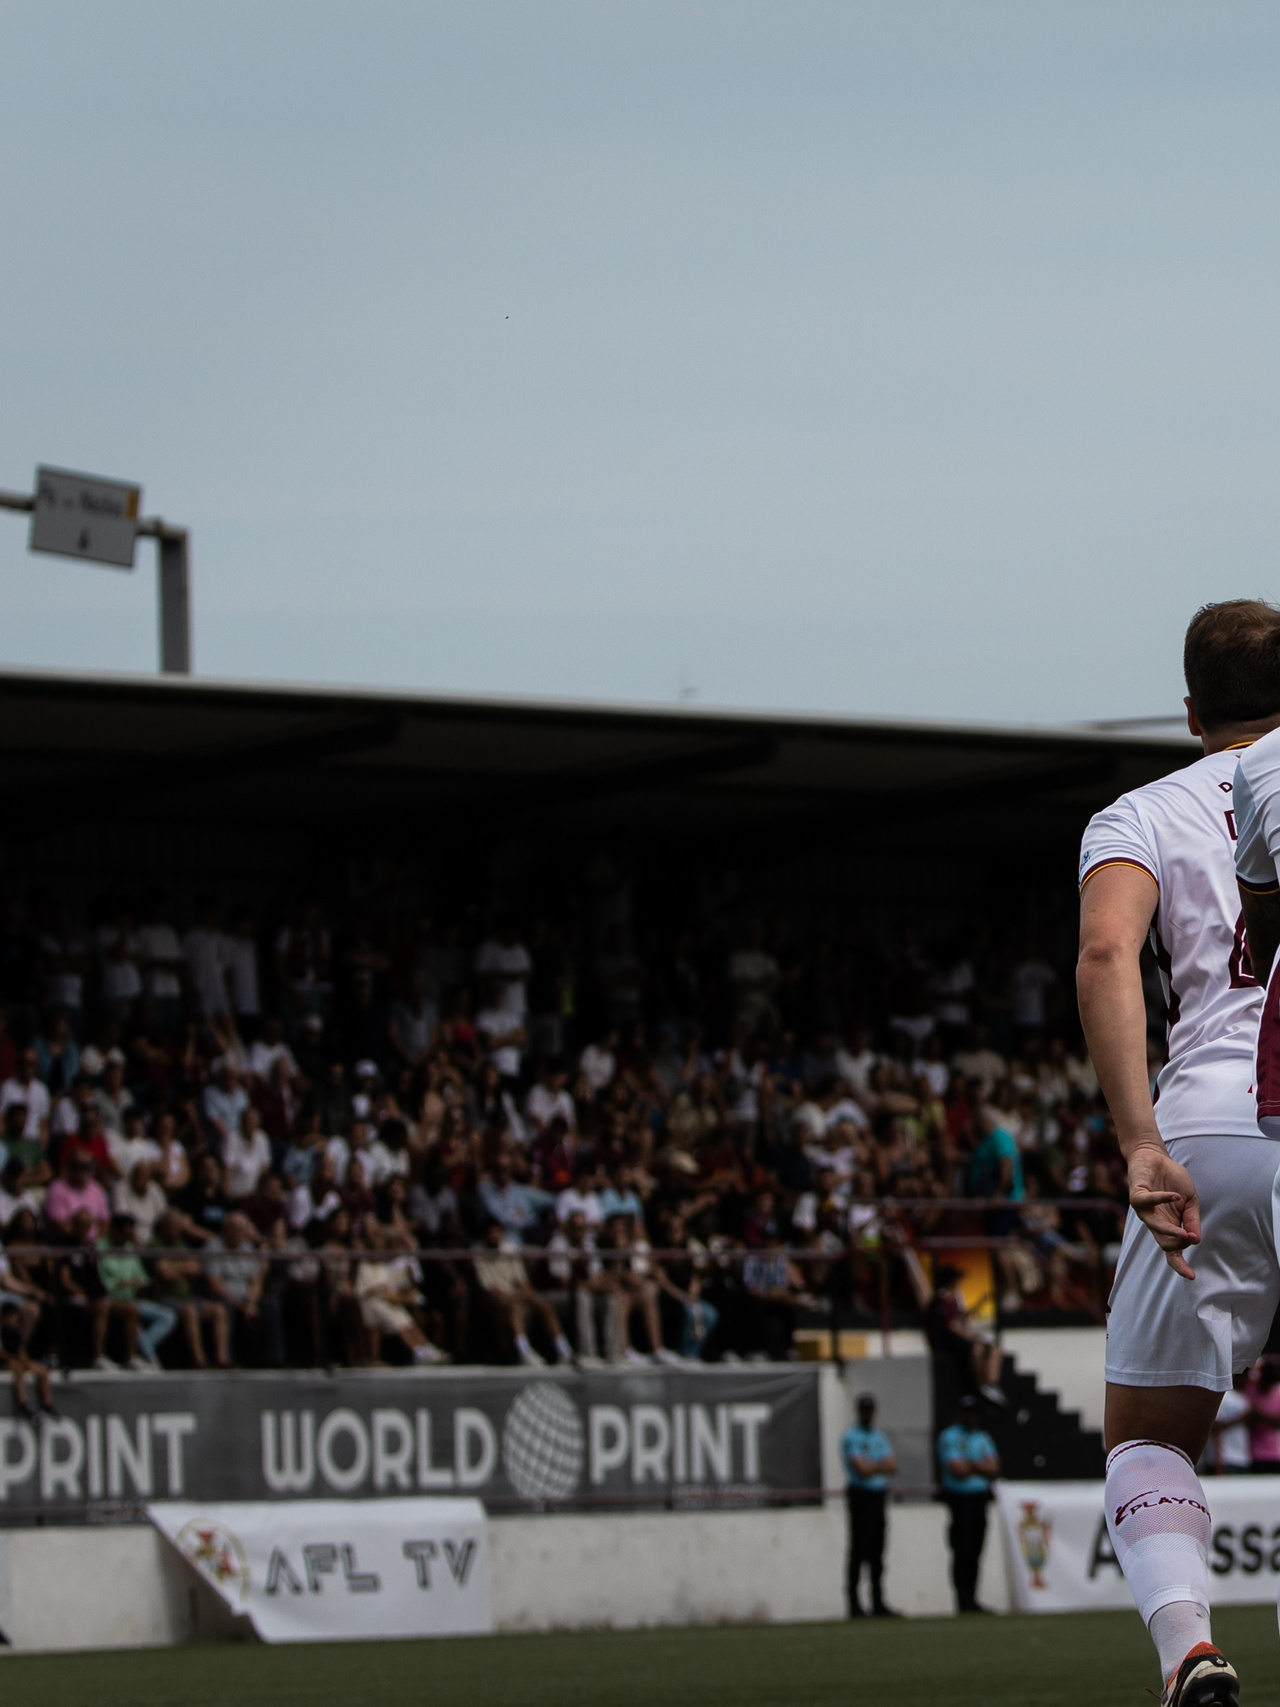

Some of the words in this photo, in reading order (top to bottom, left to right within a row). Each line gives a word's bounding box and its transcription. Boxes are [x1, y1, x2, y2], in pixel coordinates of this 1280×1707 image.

[0, 1411, 197, 1500] PRINT
[261, 1407, 498, 1492] WORLD
[589, 1403, 770, 1486] PRINT
[265, 1542, 381, 1595] AFL
[402, 1538, 477, 1590] TV
